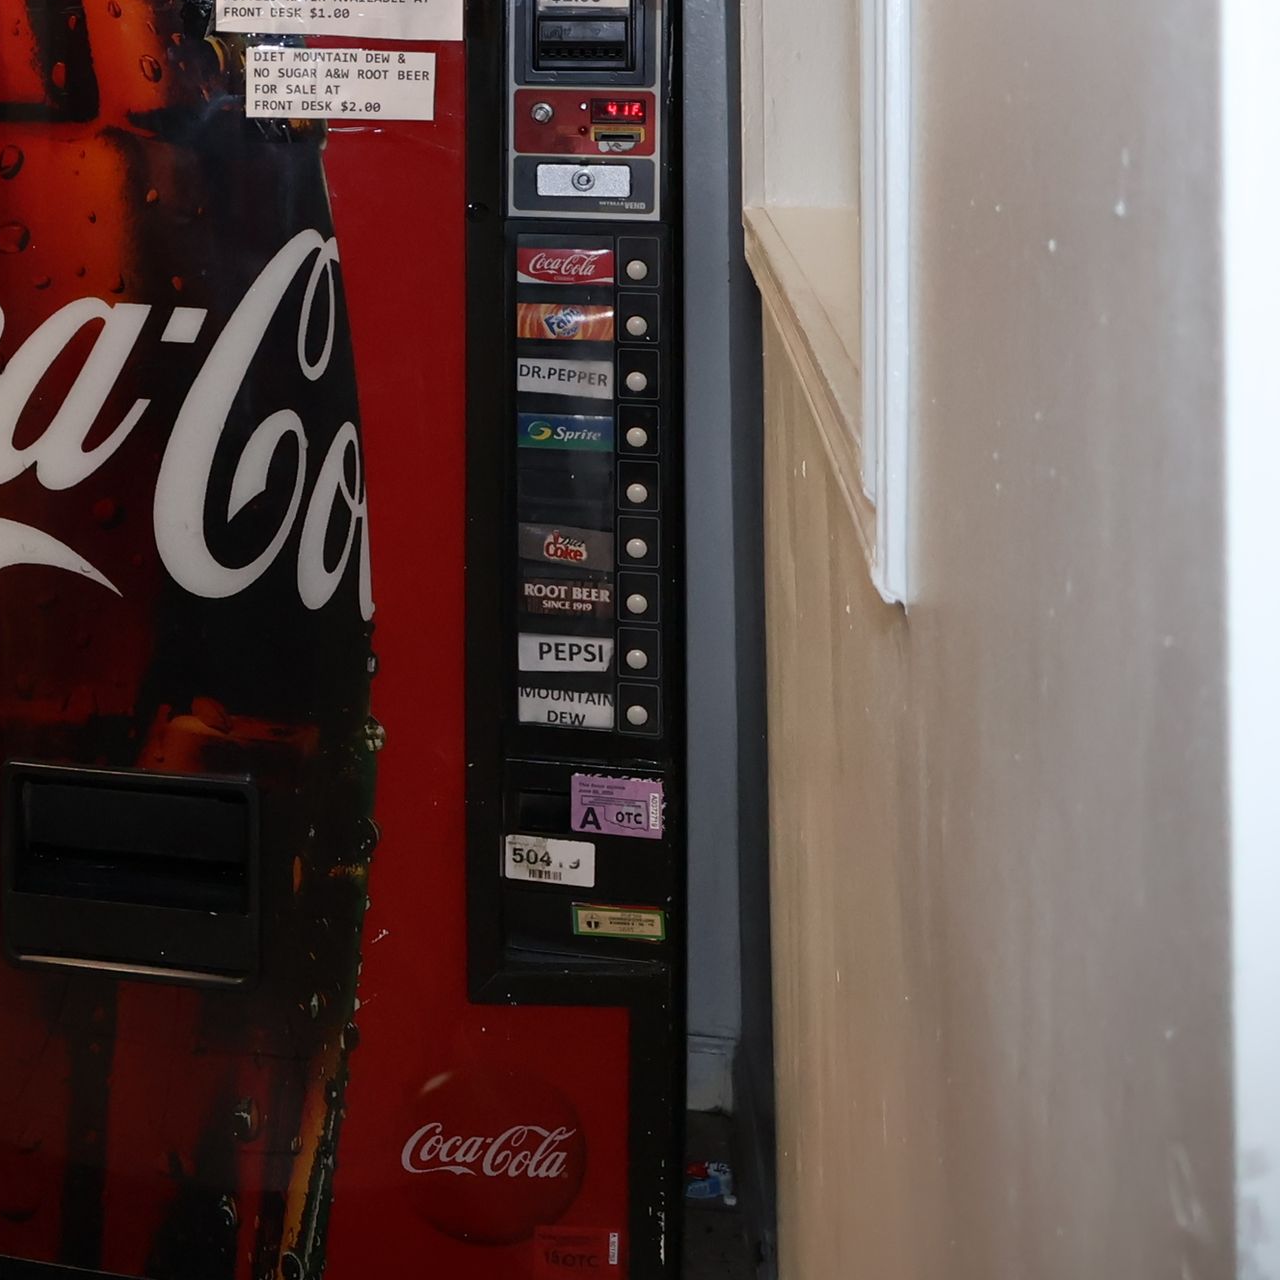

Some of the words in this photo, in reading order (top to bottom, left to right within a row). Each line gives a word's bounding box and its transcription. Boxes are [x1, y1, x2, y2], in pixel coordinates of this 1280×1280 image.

[224, 7, 262, 17] FRONT
[270, 7, 302, 18] DESK
[310, 7, 350, 20] $1.00
[254, 52, 284, 62] DIET
[293, 52, 358, 63] MOUNTAIN
[365, 53, 390, 63] DEW
[398, 54, 405, 63] &
[254, 68, 269, 78] NO
[278, 68, 317, 79] SUGAR
[325, 69, 349, 79] A&W
[357, 70, 389, 80] ROOT
[398, 70, 430, 80] BEER
[254, 84, 277, 94] FOR
[286, 85, 317, 95] SALE
[325, 85, 341, 95] AT
[254, 101, 293, 111] FRONT
[301, 101, 332, 111] DESK
[341, 100, 381, 113] $2.00
[529, 252, 598, 276] Coca-Cola
[519, 364, 608, 386] DR.PEPPER
[554, 426, 601, 442] Sprite
[545, 541, 584, 562] Coke
[524, 583, 568, 599] ROOT
[572, 585, 610, 602] BEER
[543, 600, 570, 609] SINCE
[573, 602, 592, 611] 1919
[539, 642, 604, 662] PEPSI
[520, 686, 613, 706] MOUNTAIN
[547, 710, 586, 726] DEW
[580, 807, 602, 830] A
[616, 811, 643, 824] OTC
[401, 1122, 576, 1178] Coca-Cola
